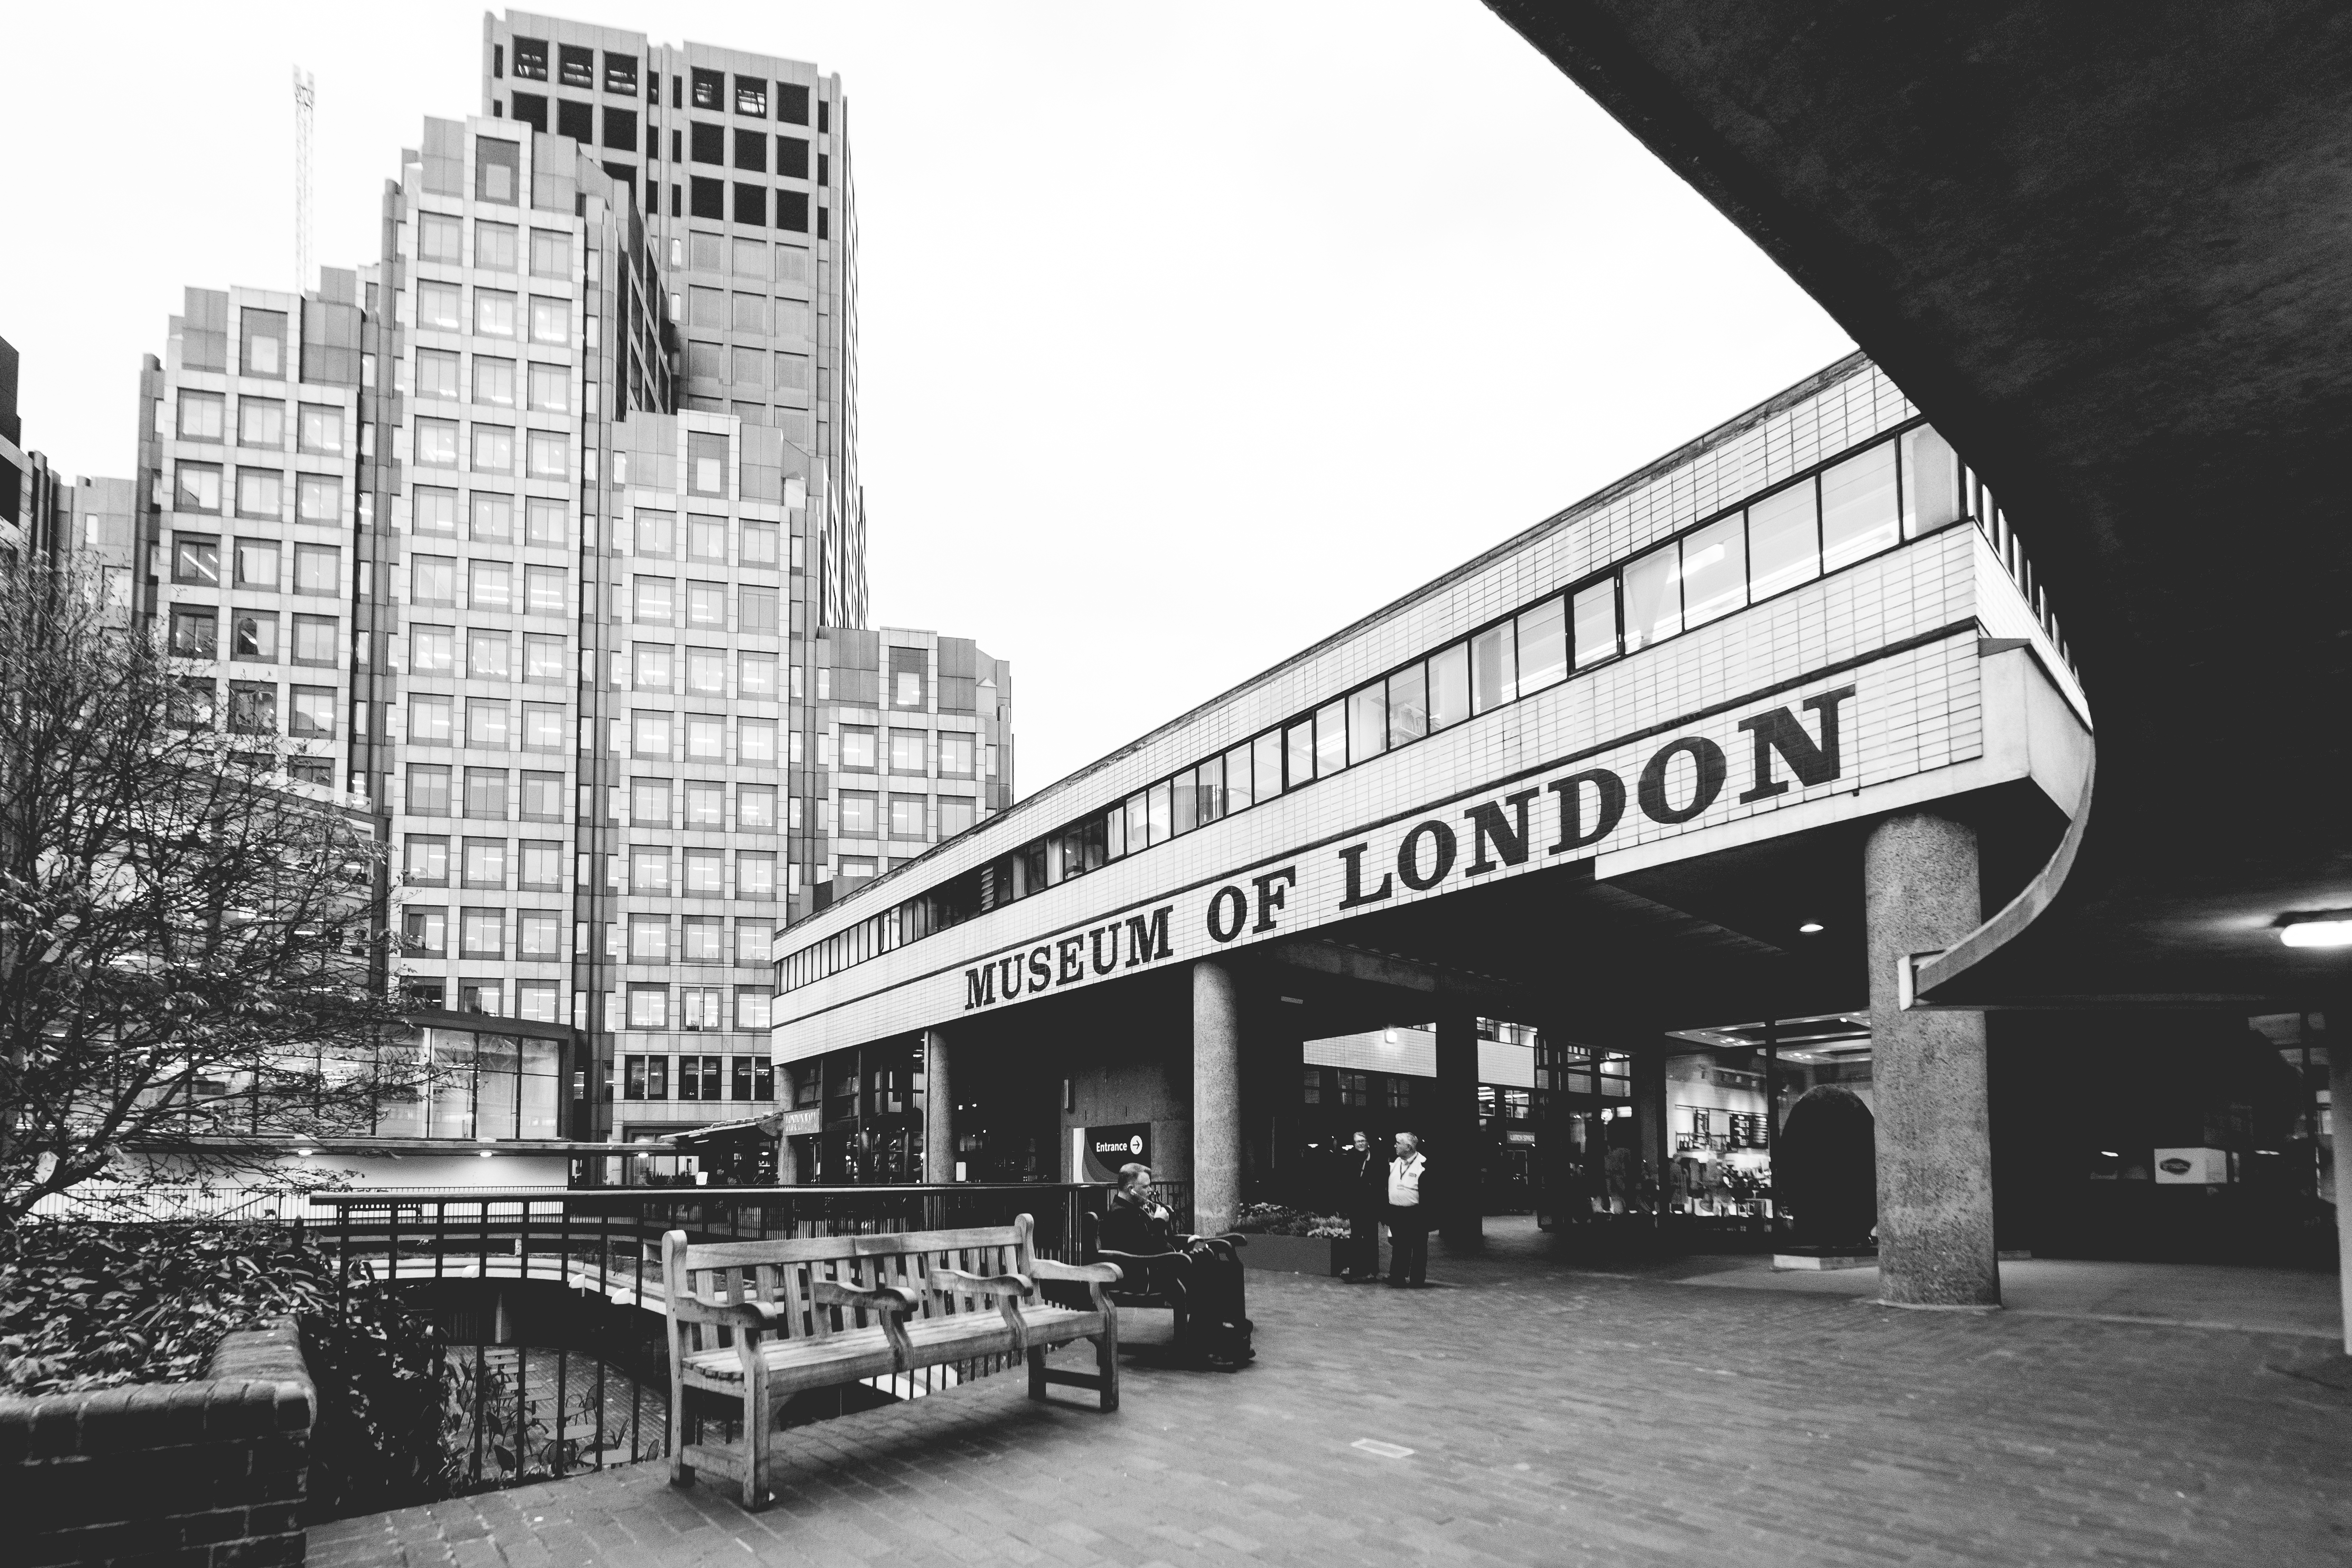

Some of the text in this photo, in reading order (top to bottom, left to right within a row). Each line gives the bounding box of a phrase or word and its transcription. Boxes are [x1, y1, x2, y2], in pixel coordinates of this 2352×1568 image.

[965, 683, 1856, 1011] MUSEUM OF LONDON
[1096, 1142, 1128, 1152] Entrance
